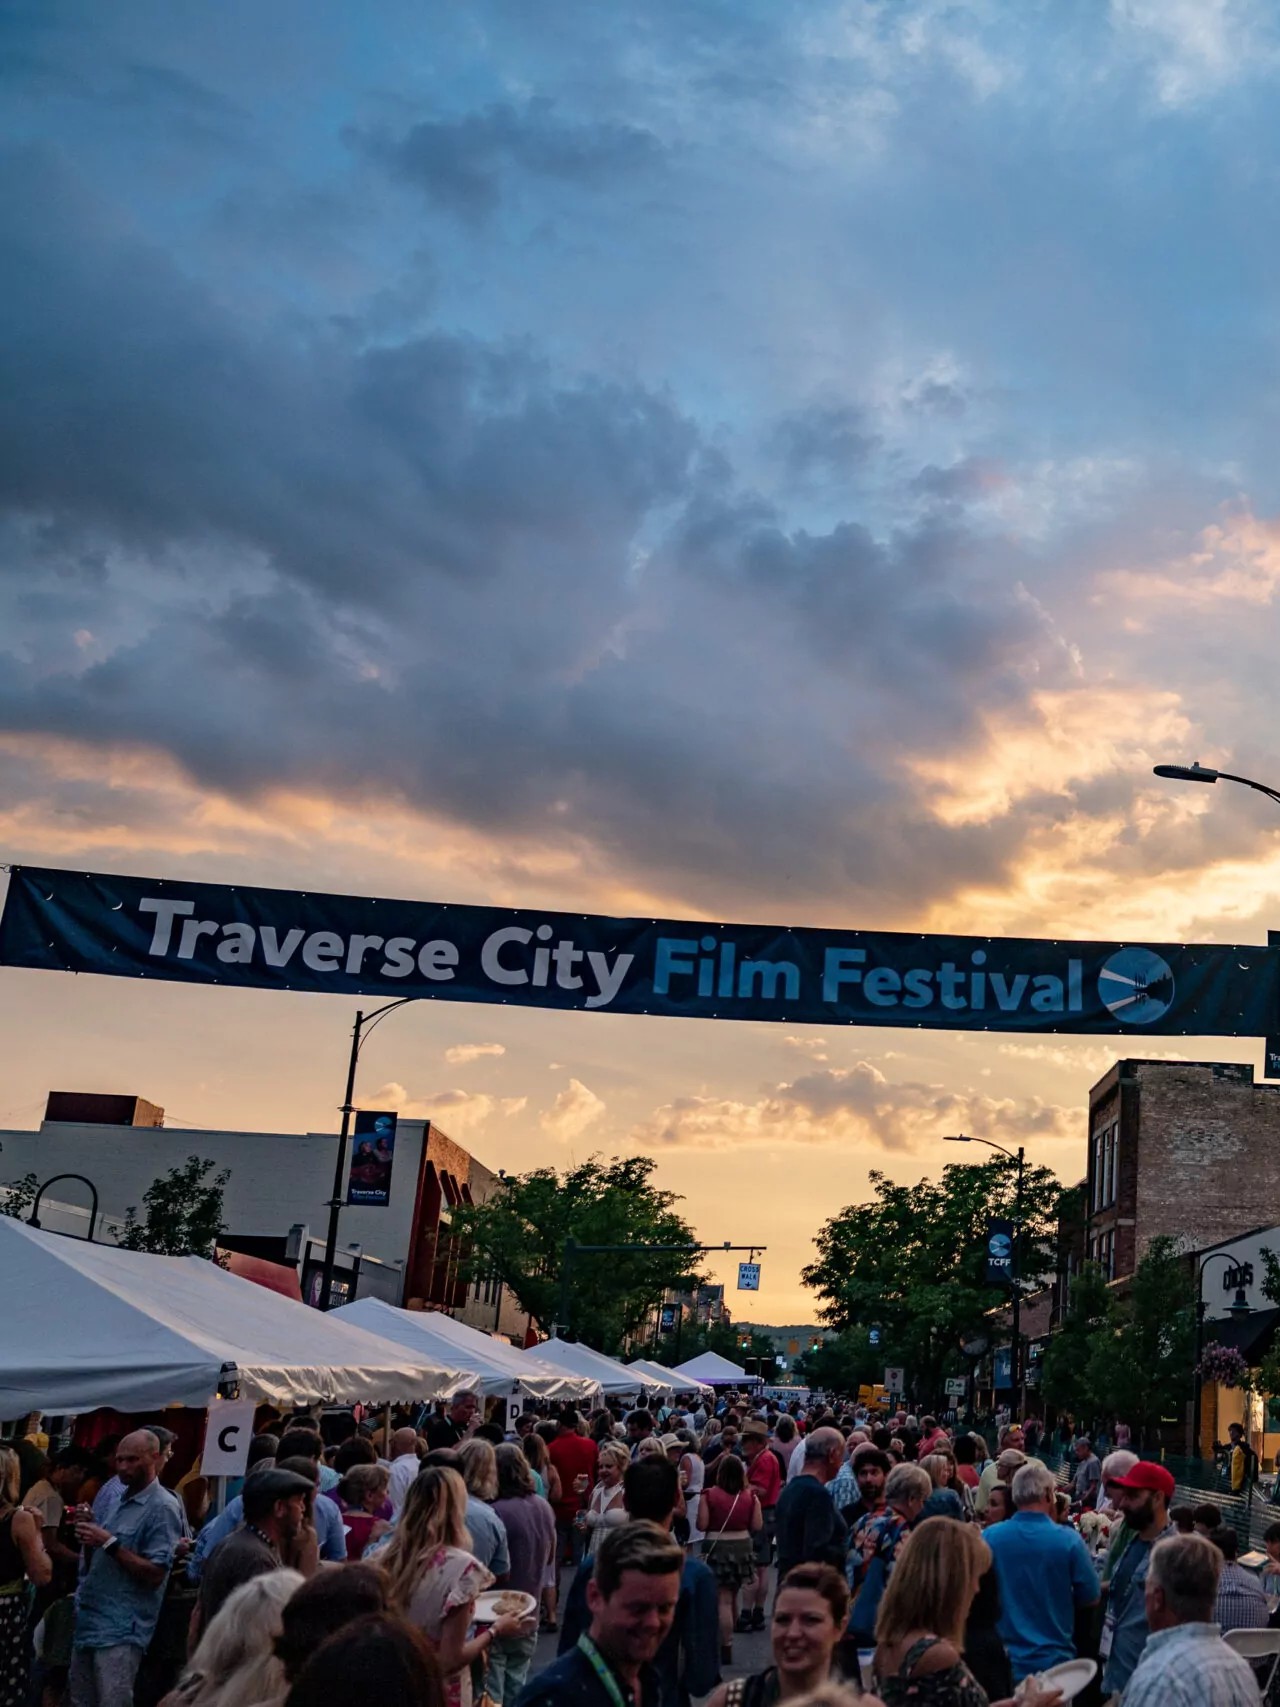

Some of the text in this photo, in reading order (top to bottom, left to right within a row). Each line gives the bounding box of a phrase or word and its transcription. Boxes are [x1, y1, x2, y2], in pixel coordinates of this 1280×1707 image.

[138, 897, 1083, 1012] Traverse City Film Festival
[988, 1257, 1011, 1266] TCFF
[740, 1265, 759, 1273] CROSS
[741, 1273, 757, 1281] WALK
[510, 1404, 520, 1419] D
[218, 1425, 240, 1453] C
